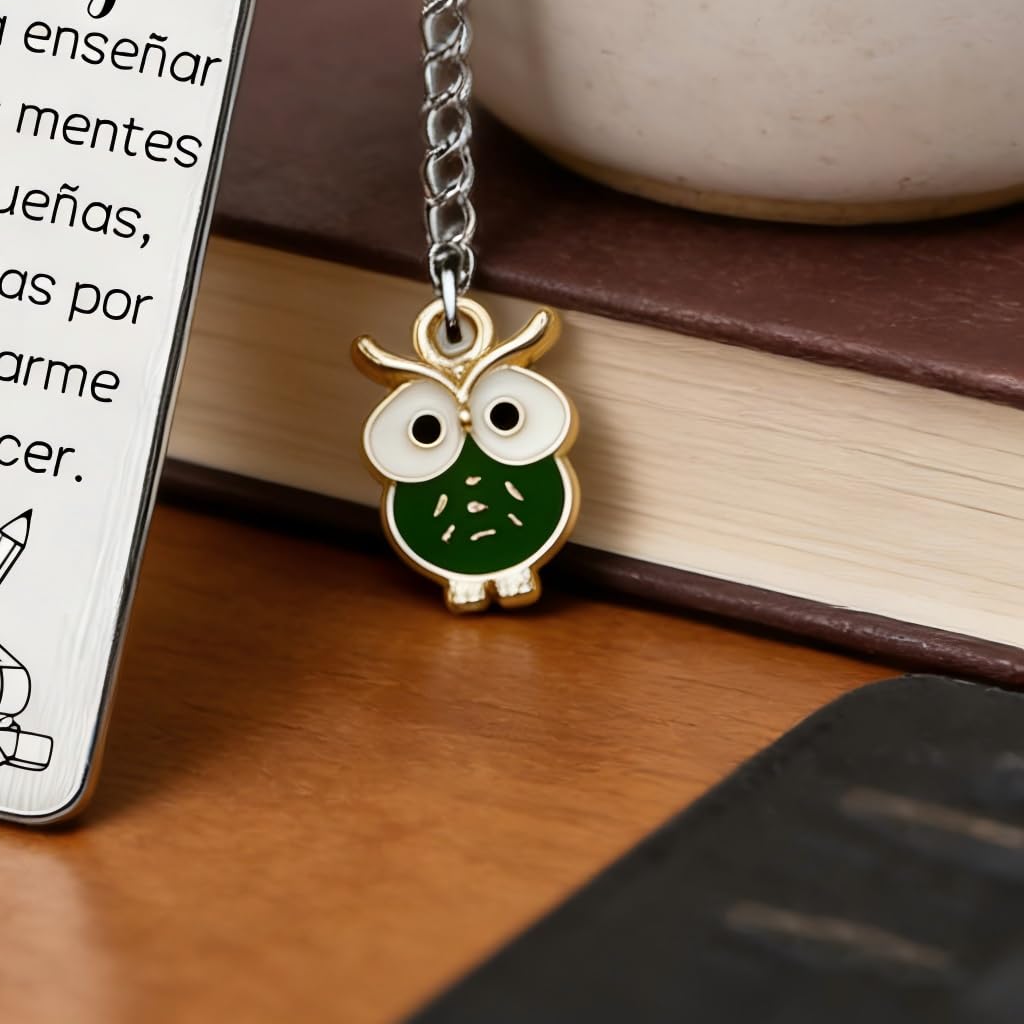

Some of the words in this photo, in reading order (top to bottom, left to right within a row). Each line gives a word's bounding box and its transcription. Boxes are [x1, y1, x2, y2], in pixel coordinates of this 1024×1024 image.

[23, 20, 223, 87] enseñar
[15, 102, 203, 169] mentes
[67, 281, 154, 325] por
